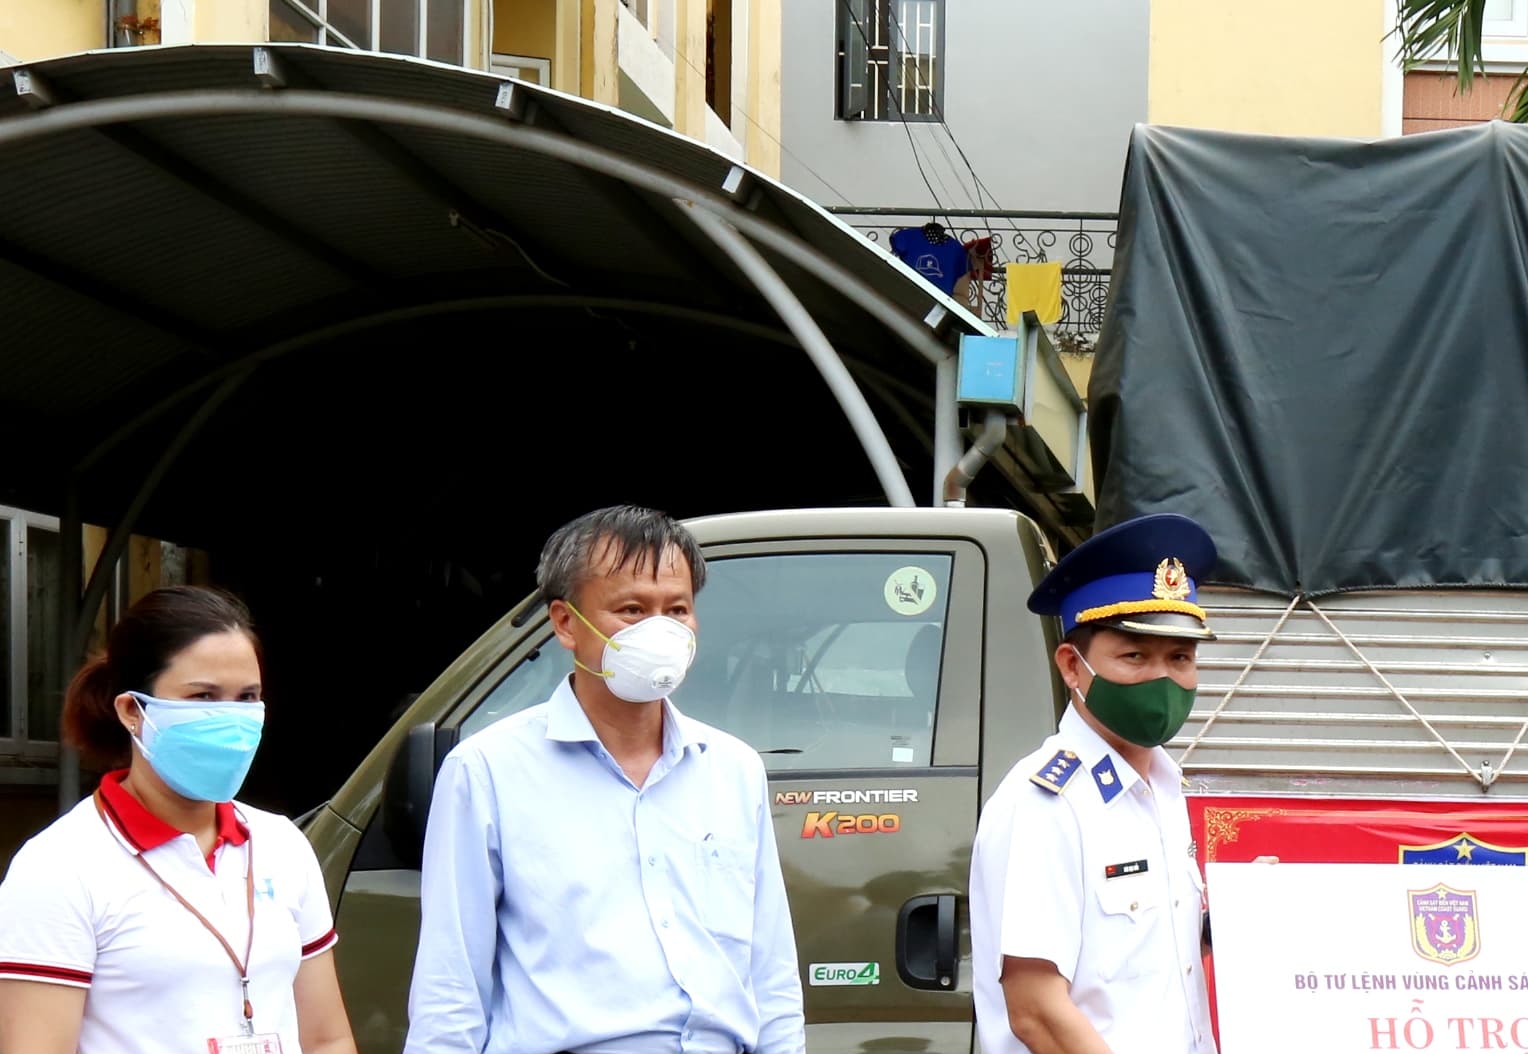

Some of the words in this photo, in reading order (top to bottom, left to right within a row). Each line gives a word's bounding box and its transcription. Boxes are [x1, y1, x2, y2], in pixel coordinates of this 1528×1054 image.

[775, 791, 812, 805] NEW
[813, 789, 919, 804] FRONTIER
[801, 811, 900, 838] K200
[1295, 971, 1318, 993] BỘ
[1324, 973, 1347, 990] TƯ
[1352, 971, 1396, 993] LỆNH
[1402, 971, 1449, 990] VÙNG
[1455, 970, 1502, 990] CẢNH
[1368, 998, 1434, 1050] HỖ
